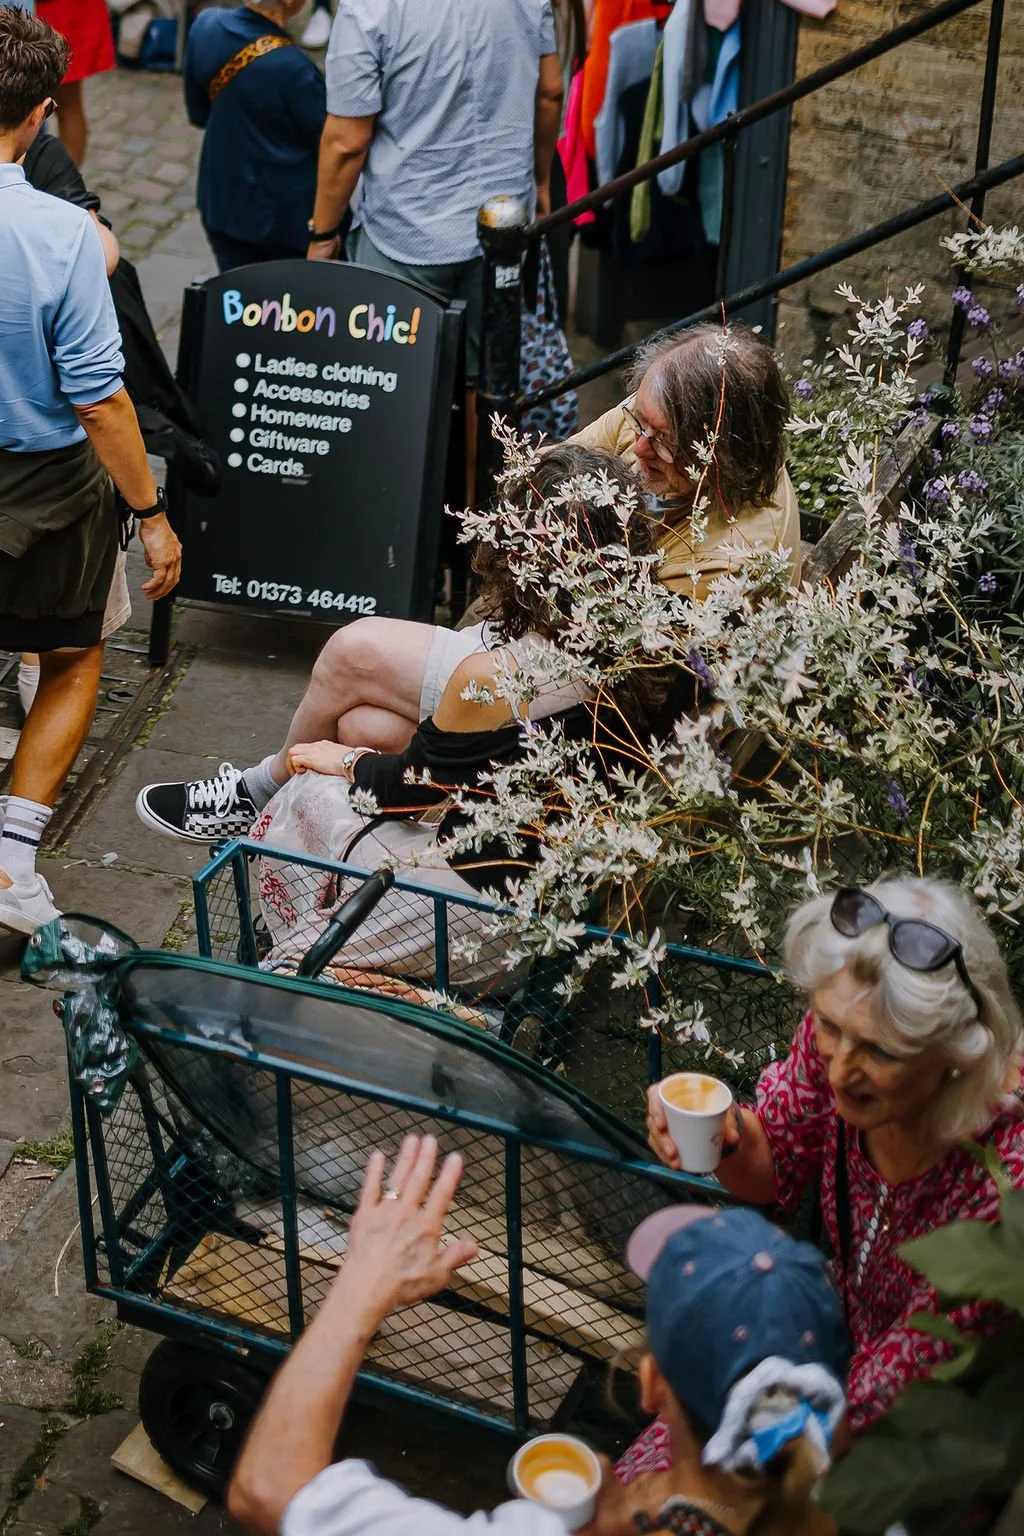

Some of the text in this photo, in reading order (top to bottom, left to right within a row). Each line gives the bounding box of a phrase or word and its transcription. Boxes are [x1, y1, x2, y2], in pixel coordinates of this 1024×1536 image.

[222, 288, 421, 345] Bonbon Chic!
[254, 353, 398, 392] Ladies clothing
[253, 379, 371, 410] Accessories
[250, 403, 353, 433] Homeware
[249, 427, 330, 455] Giftware
[247, 452, 305, 476] Cards
[212, 573, 377, 615] Tel: 01373 464412
